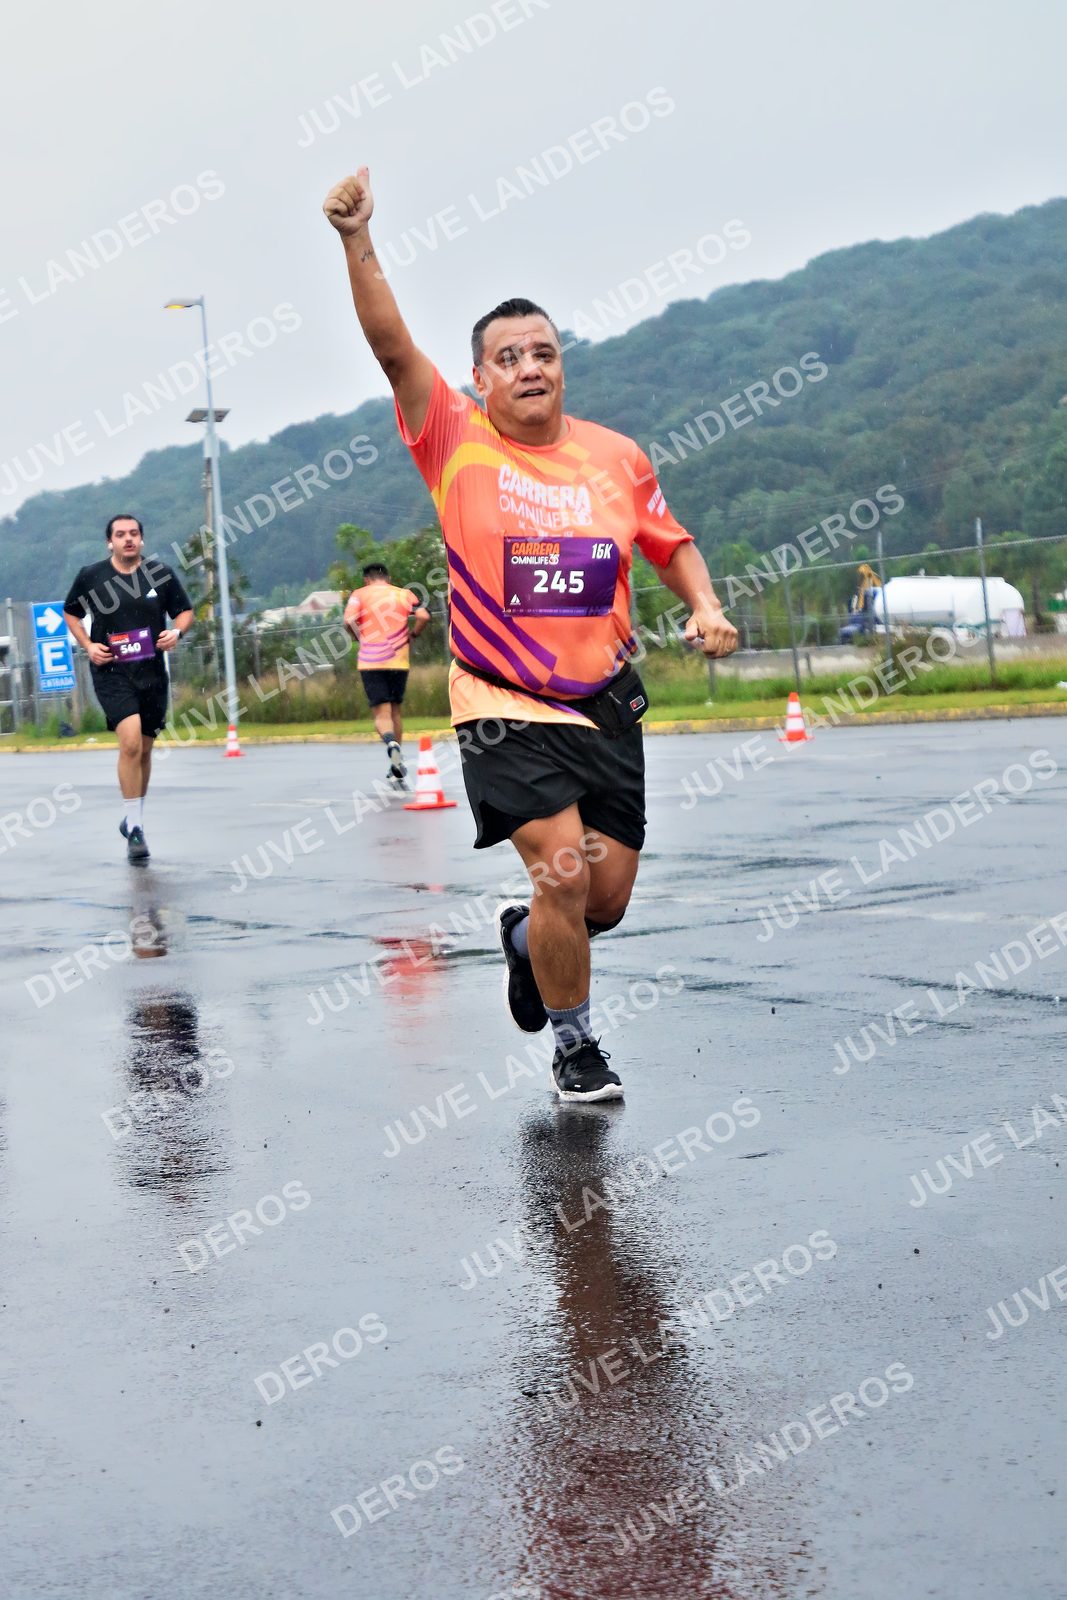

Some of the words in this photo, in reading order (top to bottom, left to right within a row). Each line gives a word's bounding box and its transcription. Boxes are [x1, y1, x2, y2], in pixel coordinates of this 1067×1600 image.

[498, 463, 592, 514] CARRERA
[511, 542, 560, 556] CARRERA
[533, 570, 584, 594] 245
[41, 641, 68, 673] E
[120, 642, 141, 654] 540
